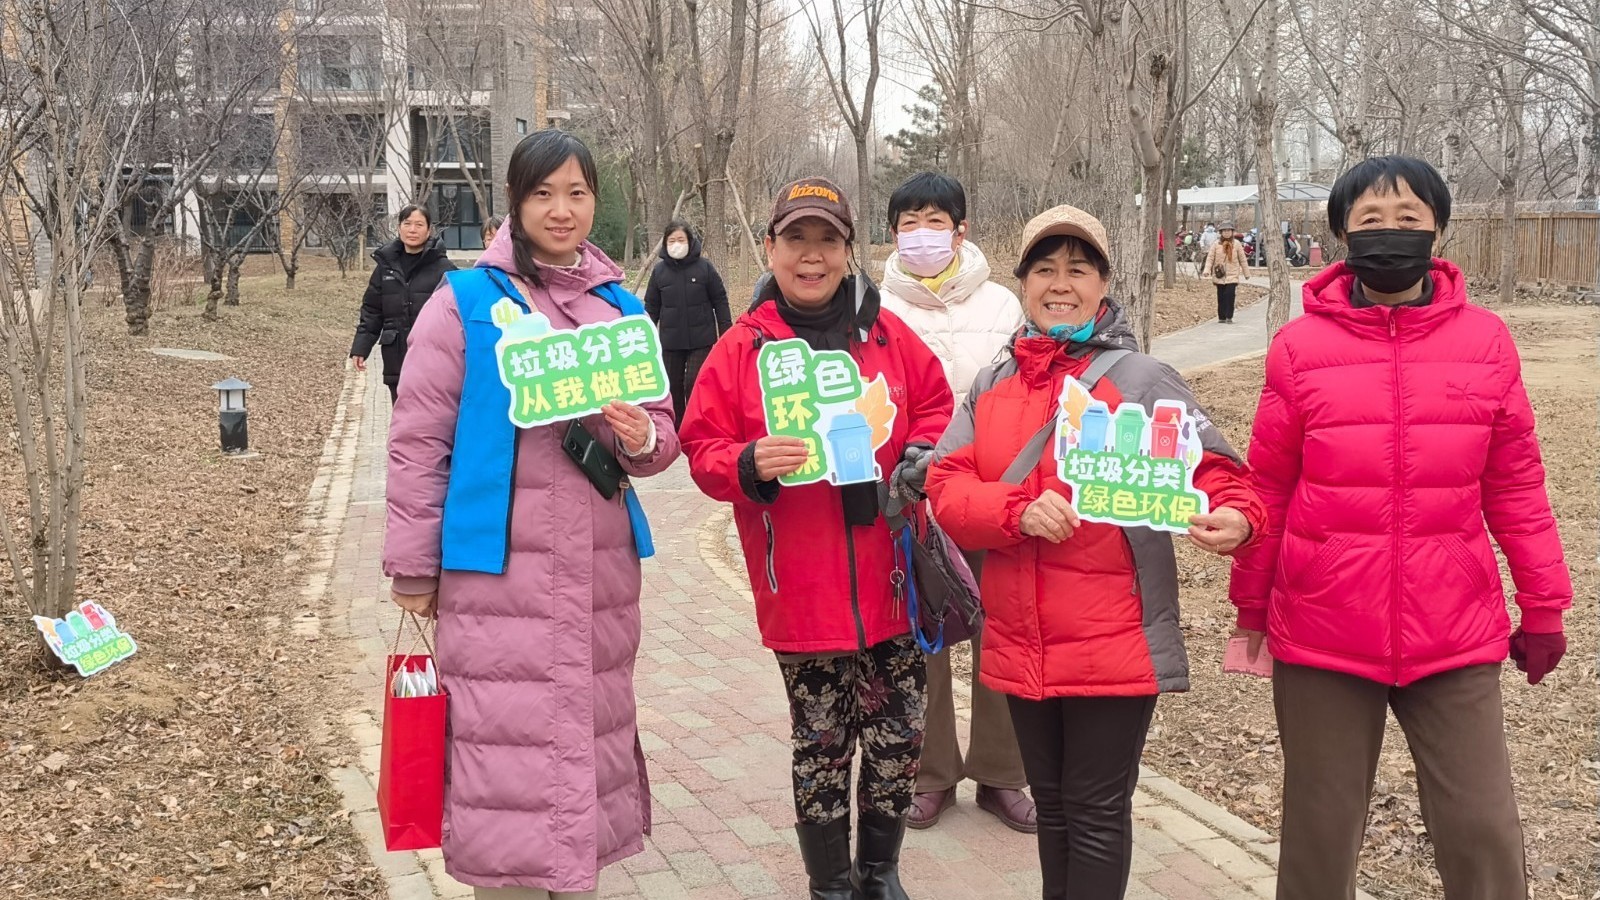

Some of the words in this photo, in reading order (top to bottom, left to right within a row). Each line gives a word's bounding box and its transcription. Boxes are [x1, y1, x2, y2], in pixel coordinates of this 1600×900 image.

[788, 184, 839, 203] Arizona
[510, 326, 649, 379] 垃圾分类
[766, 348, 855, 398] 绿色
[521, 361, 658, 416] 从我做起
[1069, 453, 1181, 490] 垃圾分类
[1081, 484, 1197, 524] 绿色环保
